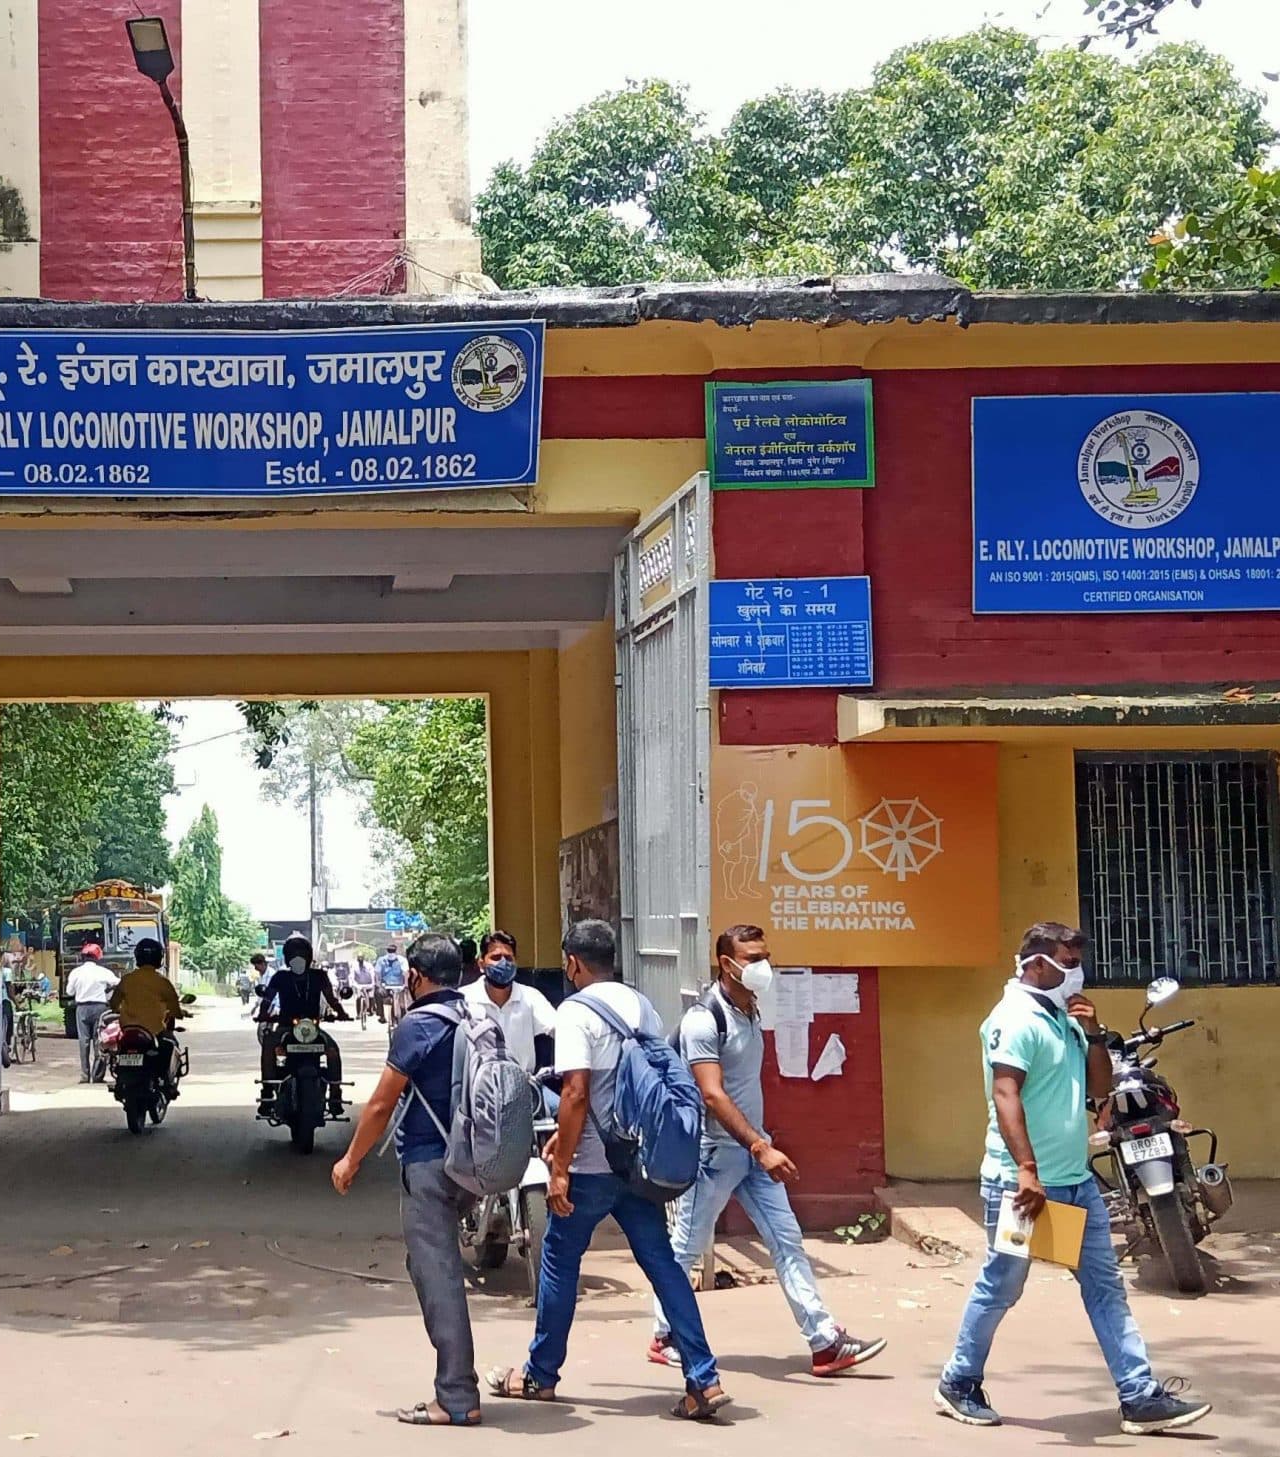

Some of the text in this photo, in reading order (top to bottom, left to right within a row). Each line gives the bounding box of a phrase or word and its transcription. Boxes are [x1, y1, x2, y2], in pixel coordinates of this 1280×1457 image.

[16, 341, 47, 385] रे.
[56, 342, 138, 391] इंजन
[145, 353, 295, 389] कारखाना,
[306, 350, 446, 400] जमालपुर
[732, 412, 848, 431] पूर्व रेलवे लोकोमोटिव
[40, 411, 186, 450] LOCOMOTIVE
[192, 411, 329, 456] WORKSHOP,
[336, 407, 457, 448] JAMALPUR
[724, 439, 857, 457] जेनरल इंजीनियरिंग वर्कशॉप
[1080, 414, 1131, 485] Jamalpur Workshop
[24, 463, 150, 484] 08.02.1862
[266, 460, 327, 486] Estd.
[350, 453, 476, 483] 08.02.1862
[1145, 511, 1171, 523] Work
[979, 540, 993, 561] E.
[996, 540, 1029, 561] RLY.
[1033, 539, 1129, 561] LOCOMOTIVE
[1131, 537, 1219, 563] WORKSHOP,
[989, 571, 1003, 582] AN
[1004, 571, 1021, 582] ISO
[1022, 571, 1043, 582] 9001
[1103, 569, 1119, 581] ISO
[1122, 569, 1170, 581] 14001:2015
[1171, 568, 1198, 582] (EMS)
[1199, 569, 1207, 580] &
[1208, 568, 1241, 580] OHSAS
[744, 582, 765, 601] गेट
[820, 583, 828, 598] 1
[1083, 589, 1204, 603] CERTIFIED ORGANISATION
[736, 600, 837, 621] खुलने का समय
[711, 632, 740, 648] सोमवार
[745, 631, 753, 647] से
[737, 658, 766, 676] शनिवार
[770, 884, 869, 899] YEARS OF
[769, 900, 907, 915] CELEBRATING
[770, 917, 916, 931] THE MAHATMA
[989, 1028, 1002, 1050] 3
